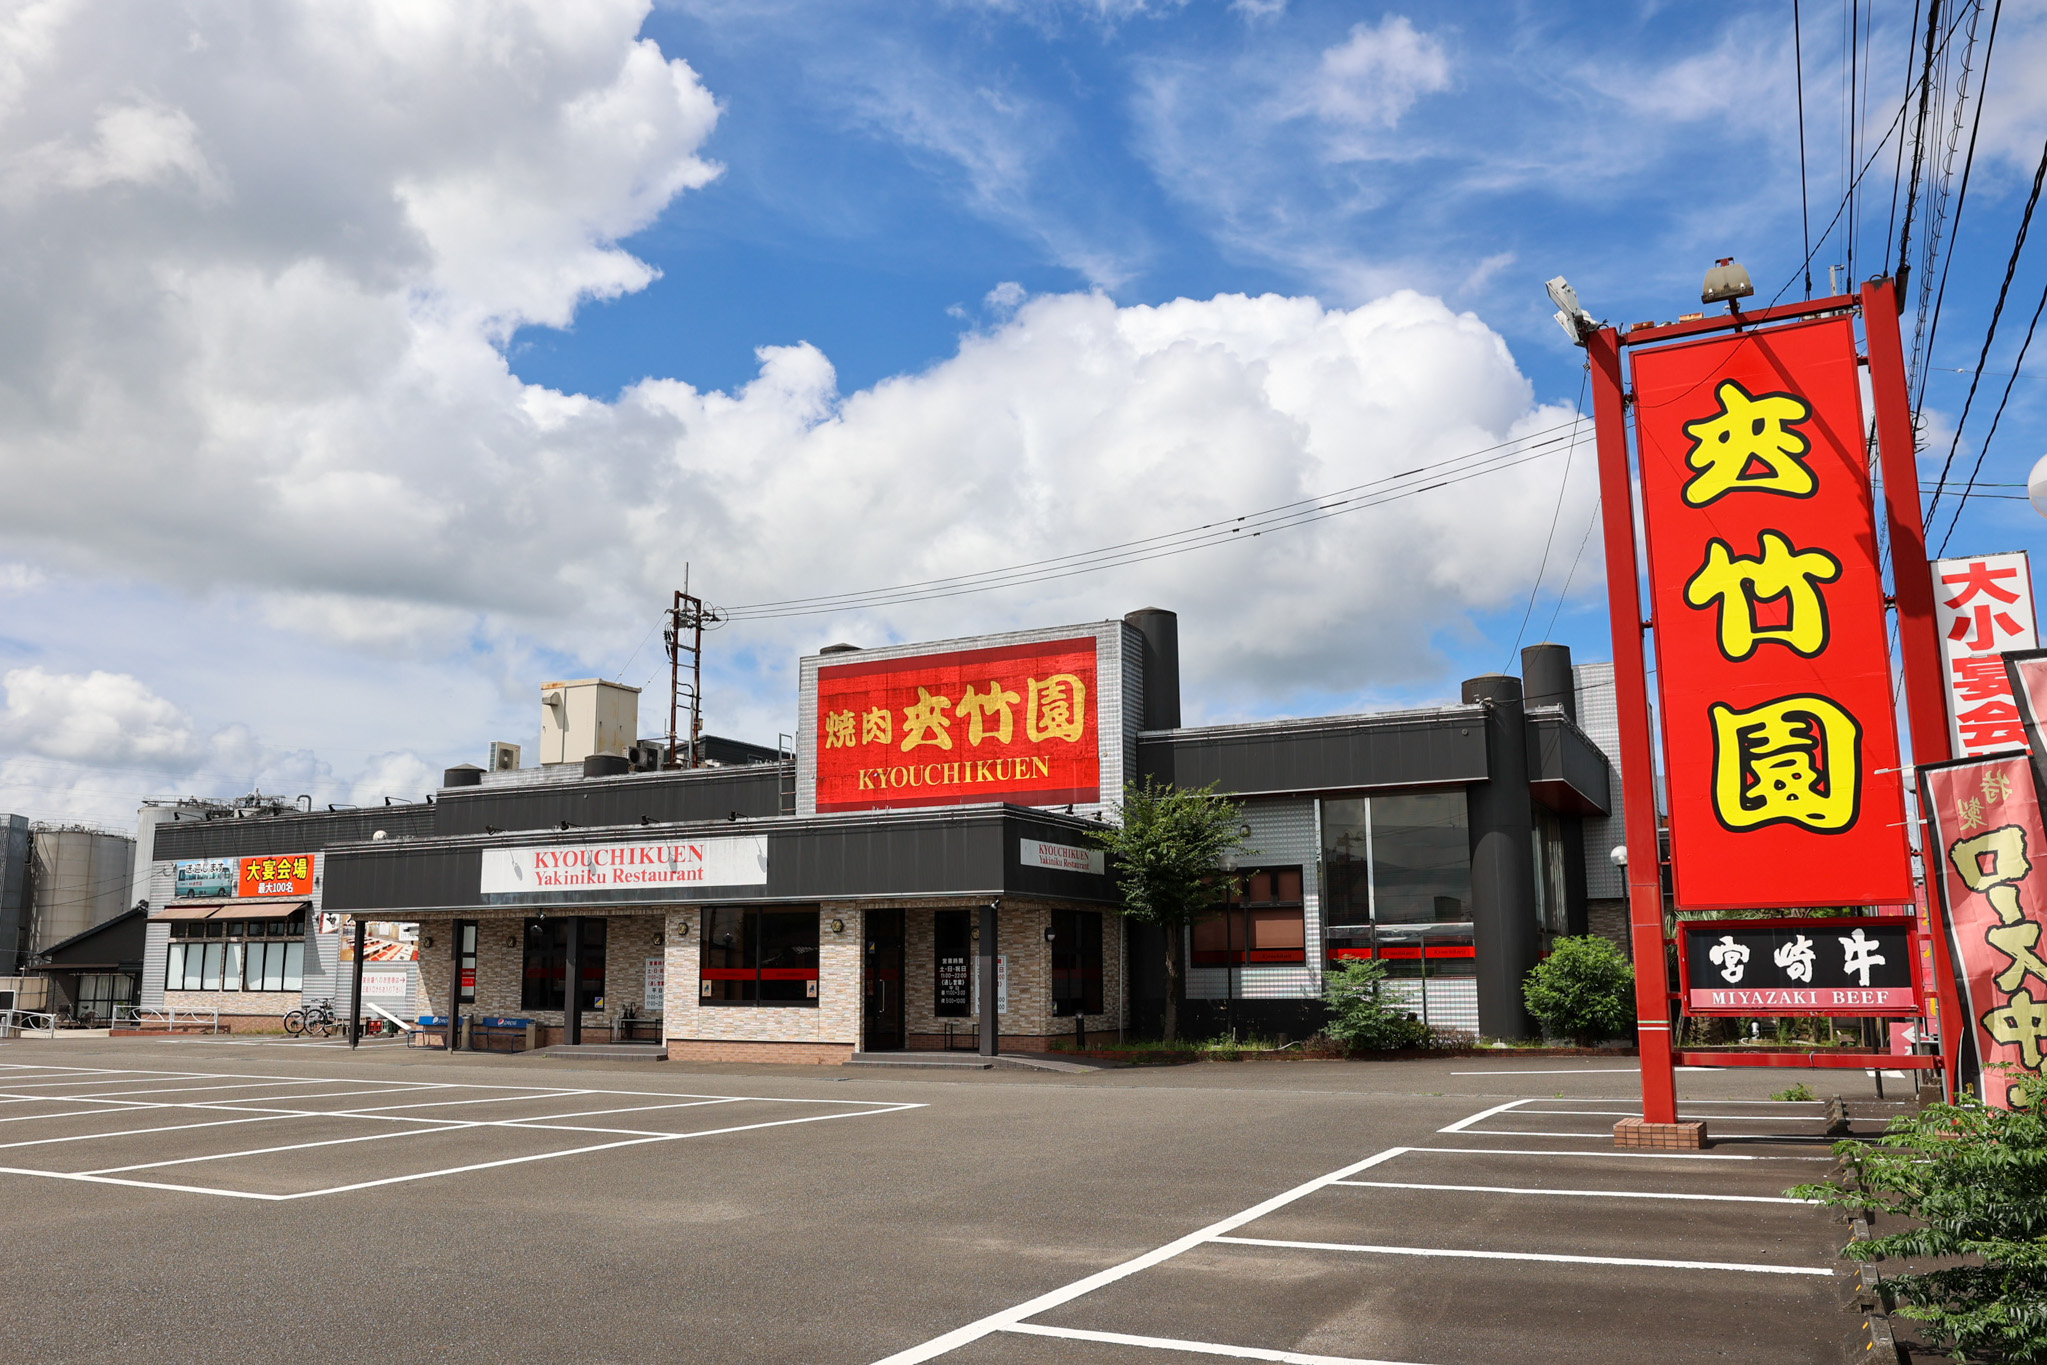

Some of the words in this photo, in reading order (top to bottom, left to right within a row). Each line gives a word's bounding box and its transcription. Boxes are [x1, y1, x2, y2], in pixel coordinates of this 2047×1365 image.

[1942, 561, 2033, 757] 大小宴会
[858, 756, 1050, 790] KYOUCHIKUEN
[534, 844, 705, 869] KYOUCHIKUEN
[1038, 844, 1089, 860] KYOUCHIKUEN
[1039, 855, 1062, 866] Yakiniku
[1063, 859, 1090, 870] Restaurant
[246, 857, 308, 881] 大宴会場
[534, 869, 607, 886] Yakiniku
[612, 866, 705, 883] Restaurant
[258, 882, 294, 894] 最大100名
[1709, 928, 1886, 987] 宮崎牛
[1712, 991, 1817, 1005] MIYAZAKI
[1833, 991, 1889, 1004] BEEF
